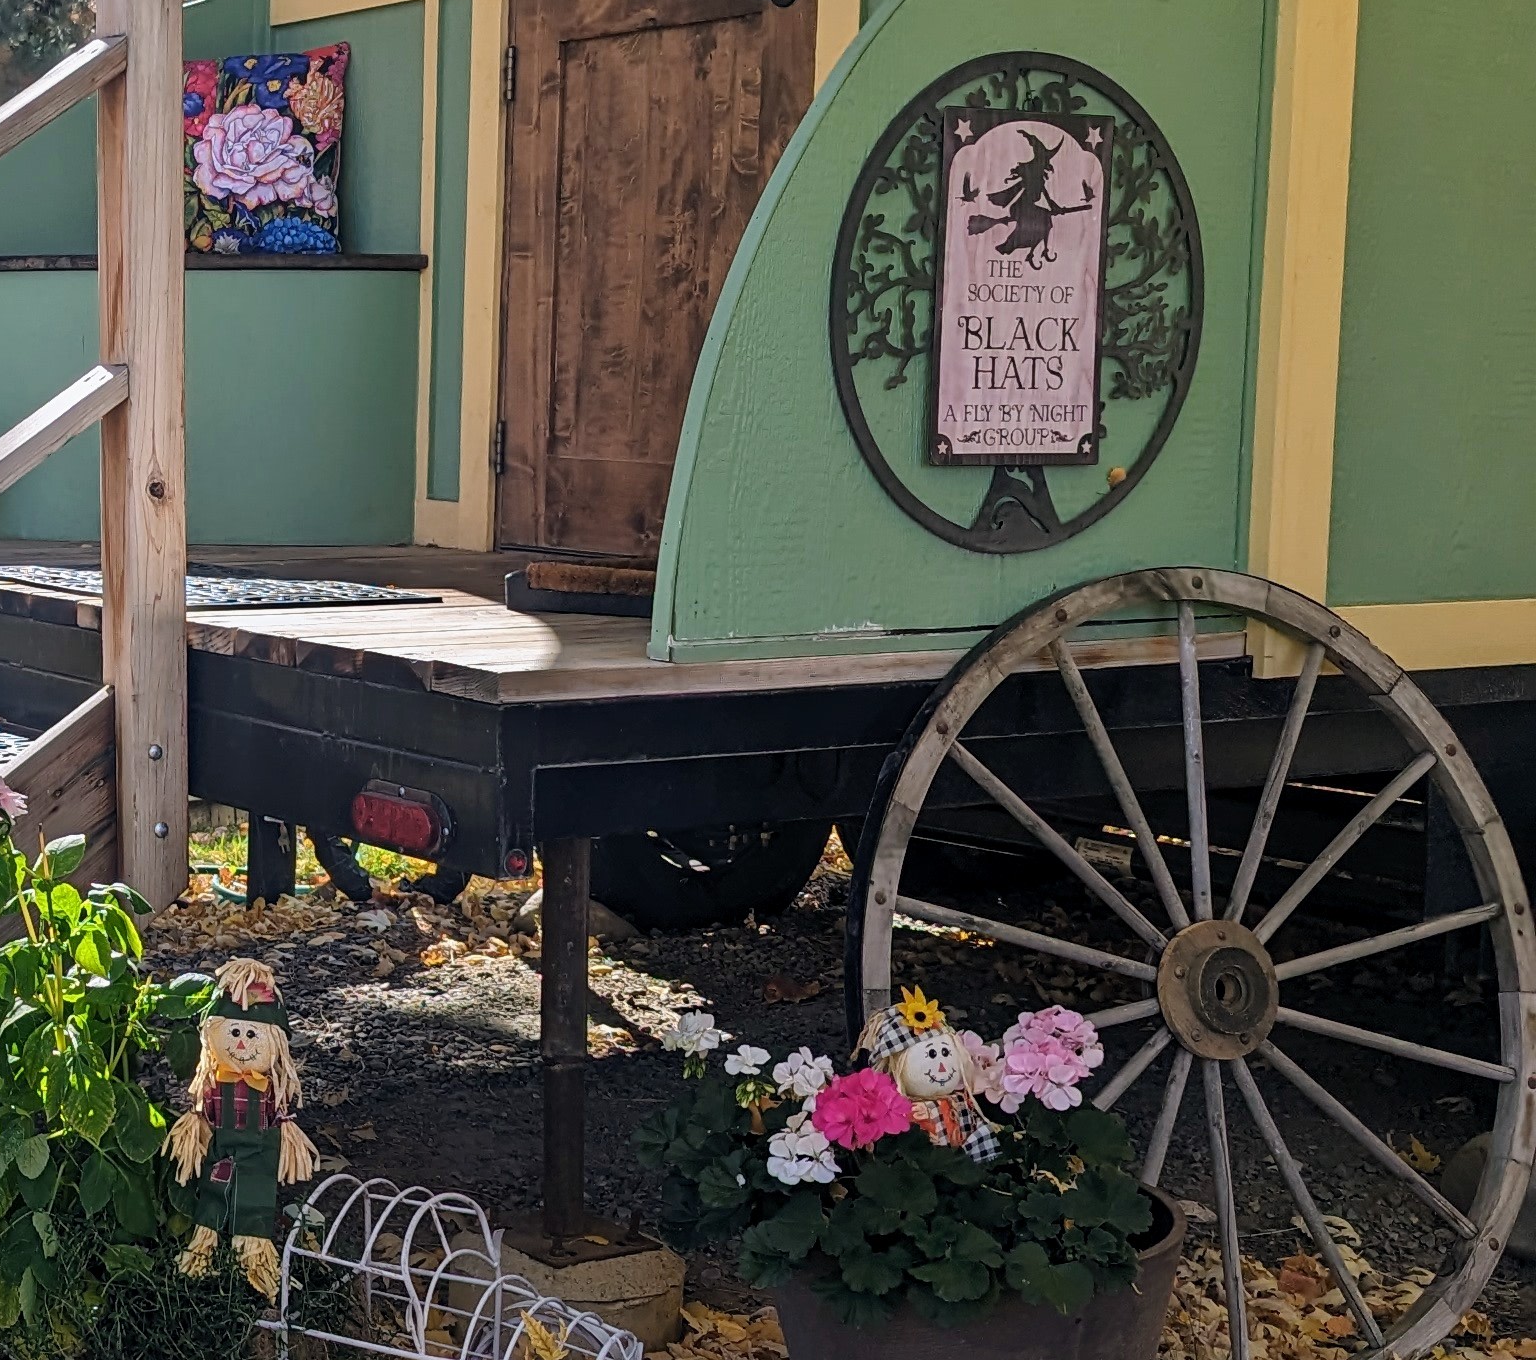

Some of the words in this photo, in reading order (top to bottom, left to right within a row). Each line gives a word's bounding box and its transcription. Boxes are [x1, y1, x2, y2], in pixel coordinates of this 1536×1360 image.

[986, 259, 1024, 278] THE
[967, 283, 1045, 303] SOCIETY
[1050, 285, 1075, 304] OF
[957, 315, 1081, 352] BLACK
[972, 355, 1064, 391] HATS
[943, 404, 958, 423] A
[963, 404, 994, 423] FLY
[998, 403, 1025, 423] BY
[1029, 403, 1089, 423] NIGHT
[983, 427, 1050, 447] GROUP
